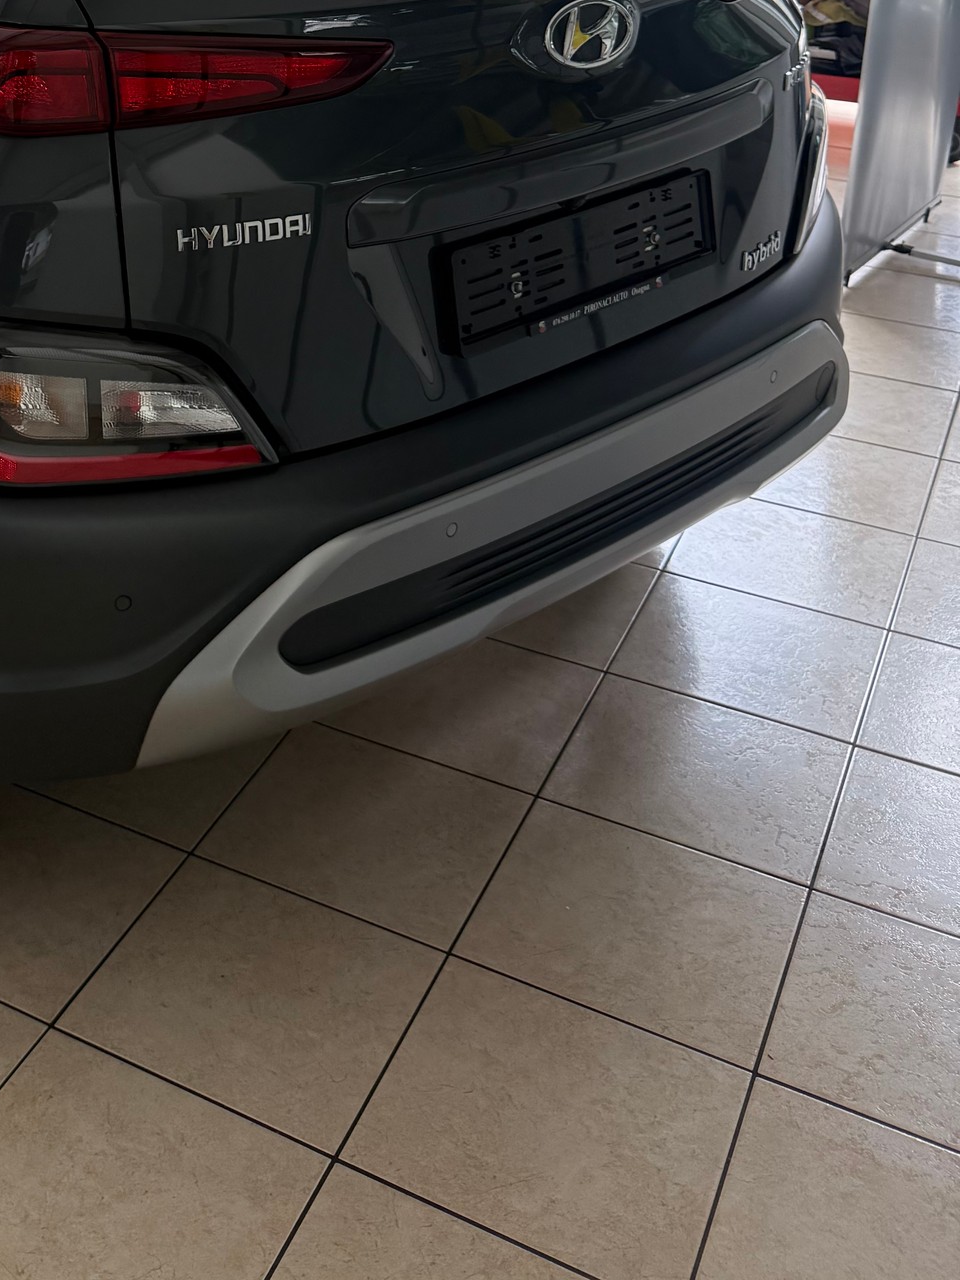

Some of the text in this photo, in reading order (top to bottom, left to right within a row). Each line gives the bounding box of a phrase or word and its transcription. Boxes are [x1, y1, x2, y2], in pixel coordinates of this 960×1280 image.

[176, 212, 312, 252] HYUNDAI
[743, 230, 781, 271] hybrid
[611, 290, 628, 304] AUTO
